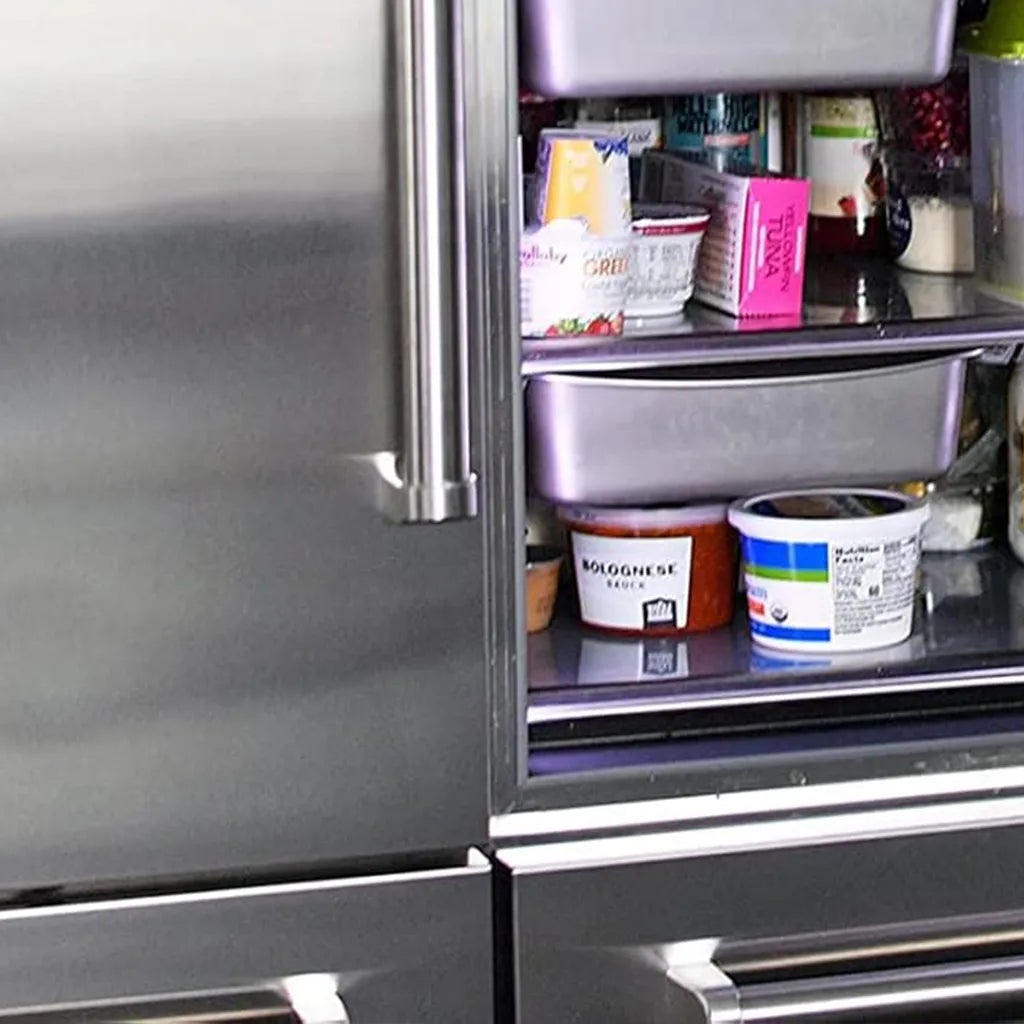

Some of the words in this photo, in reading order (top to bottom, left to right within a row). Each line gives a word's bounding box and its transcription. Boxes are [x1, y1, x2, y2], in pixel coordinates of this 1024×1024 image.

[764, 213, 785, 279] TUNA
[582, 559, 677, 577] BOLOGNESE
[606, 579, 646, 589] SAUCE
